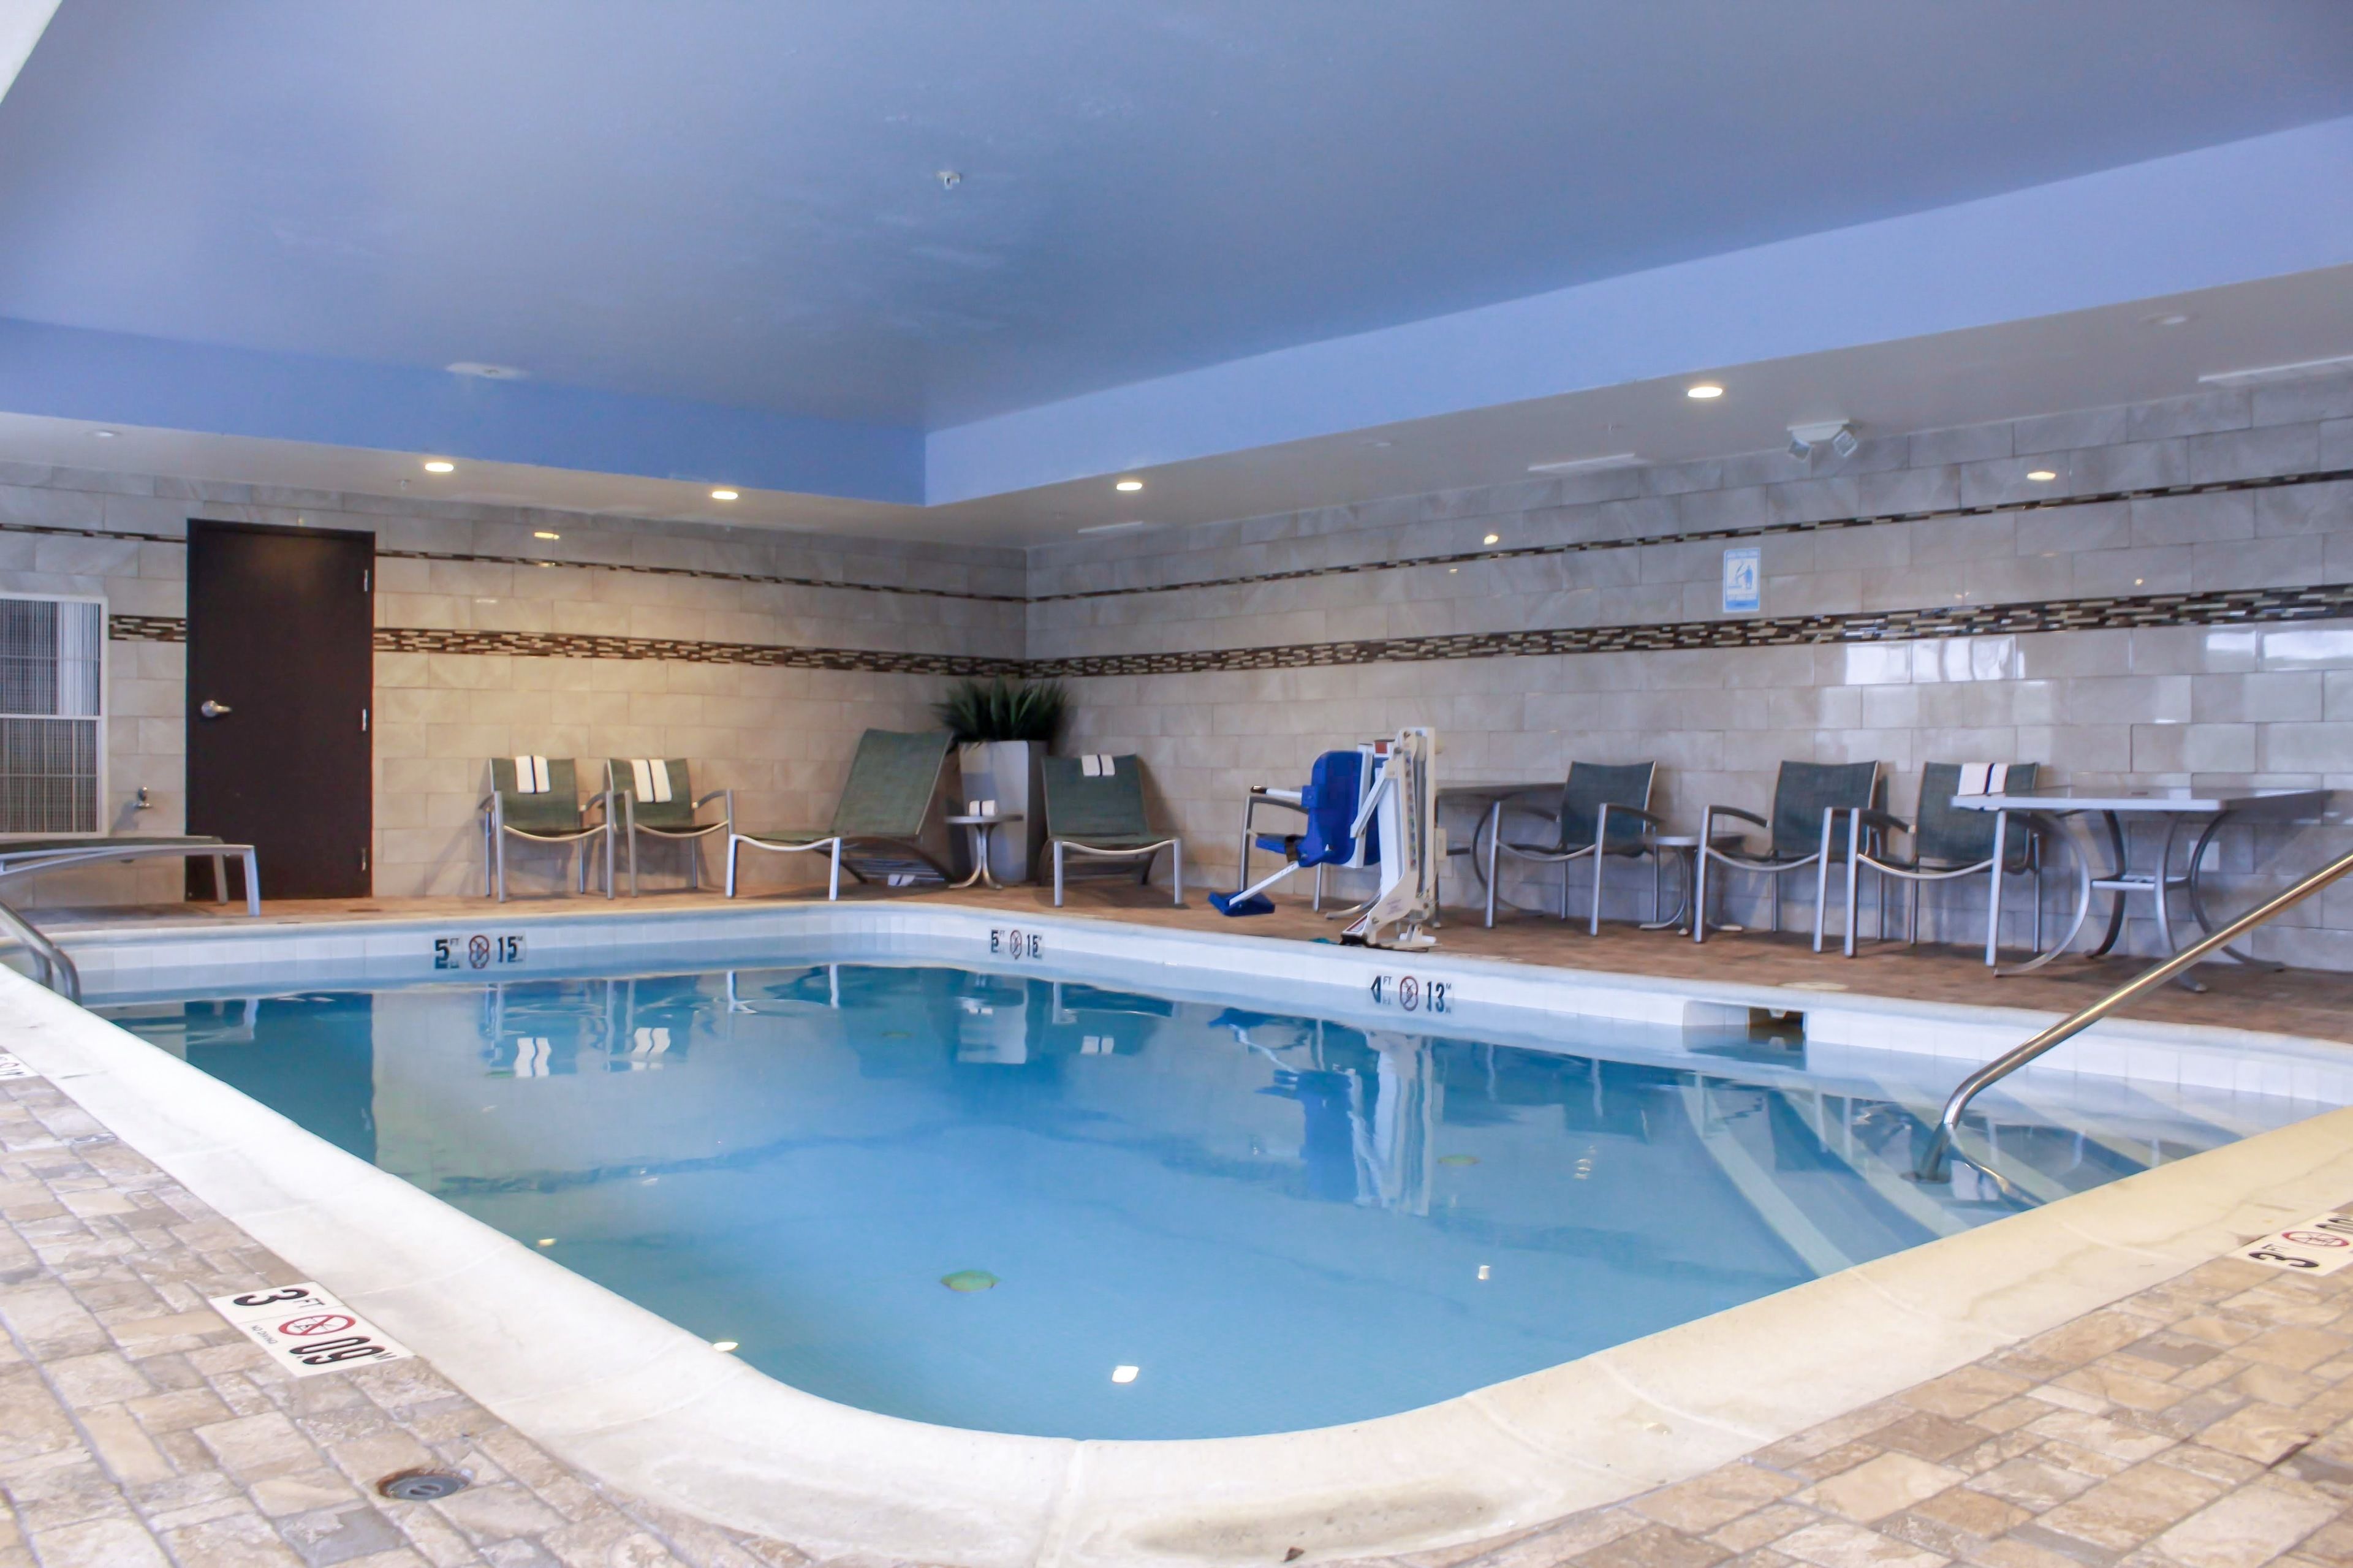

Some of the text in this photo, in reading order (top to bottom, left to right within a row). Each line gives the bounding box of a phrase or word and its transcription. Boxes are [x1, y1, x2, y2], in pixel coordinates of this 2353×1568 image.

[434, 939, 449, 963] 5
[1383, 976, 1392, 985] FT
[2249, 1249, 2320, 1268] 3
[233, 1287, 309, 1306] 3
[292, 1297, 326, 1308] FT
